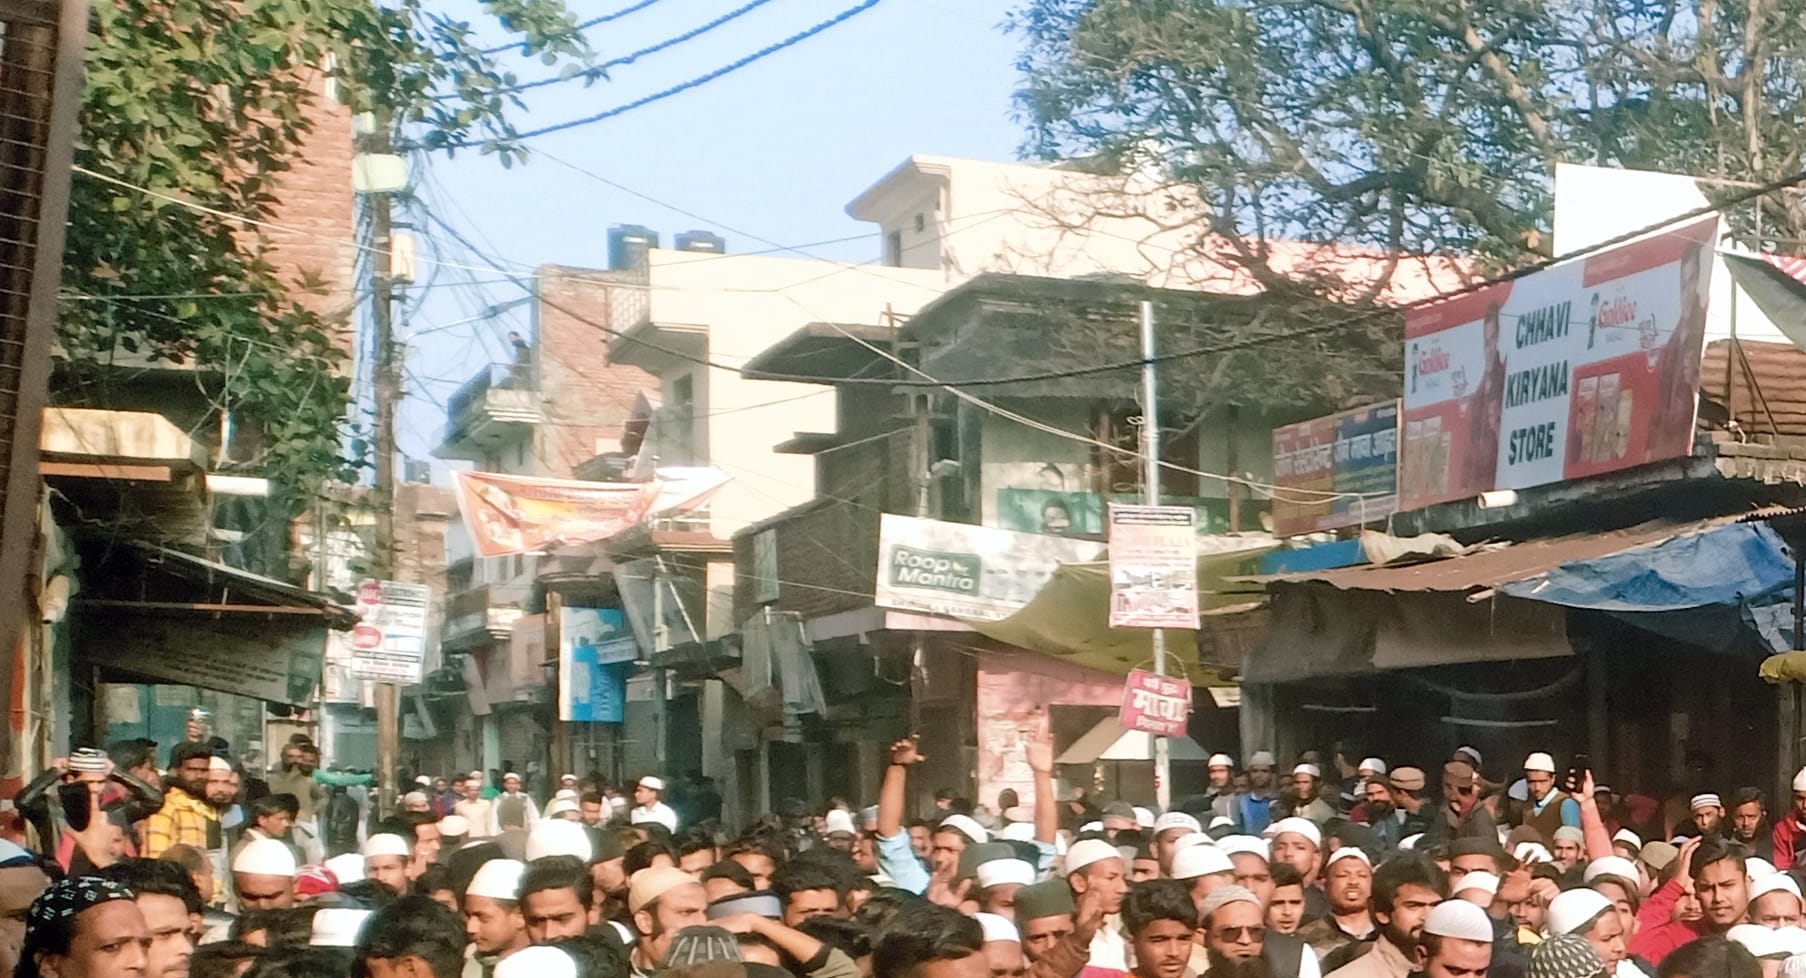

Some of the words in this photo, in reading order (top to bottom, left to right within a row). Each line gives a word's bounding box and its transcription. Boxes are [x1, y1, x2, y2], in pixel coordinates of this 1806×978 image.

[1515, 300, 1571, 350] CHHAVI
[1505, 359, 1569, 409] KIRYANA
[1508, 421, 1556, 466] STORE
[894, 548, 949, 572] Roop
[898, 567, 975, 592] Mantra
